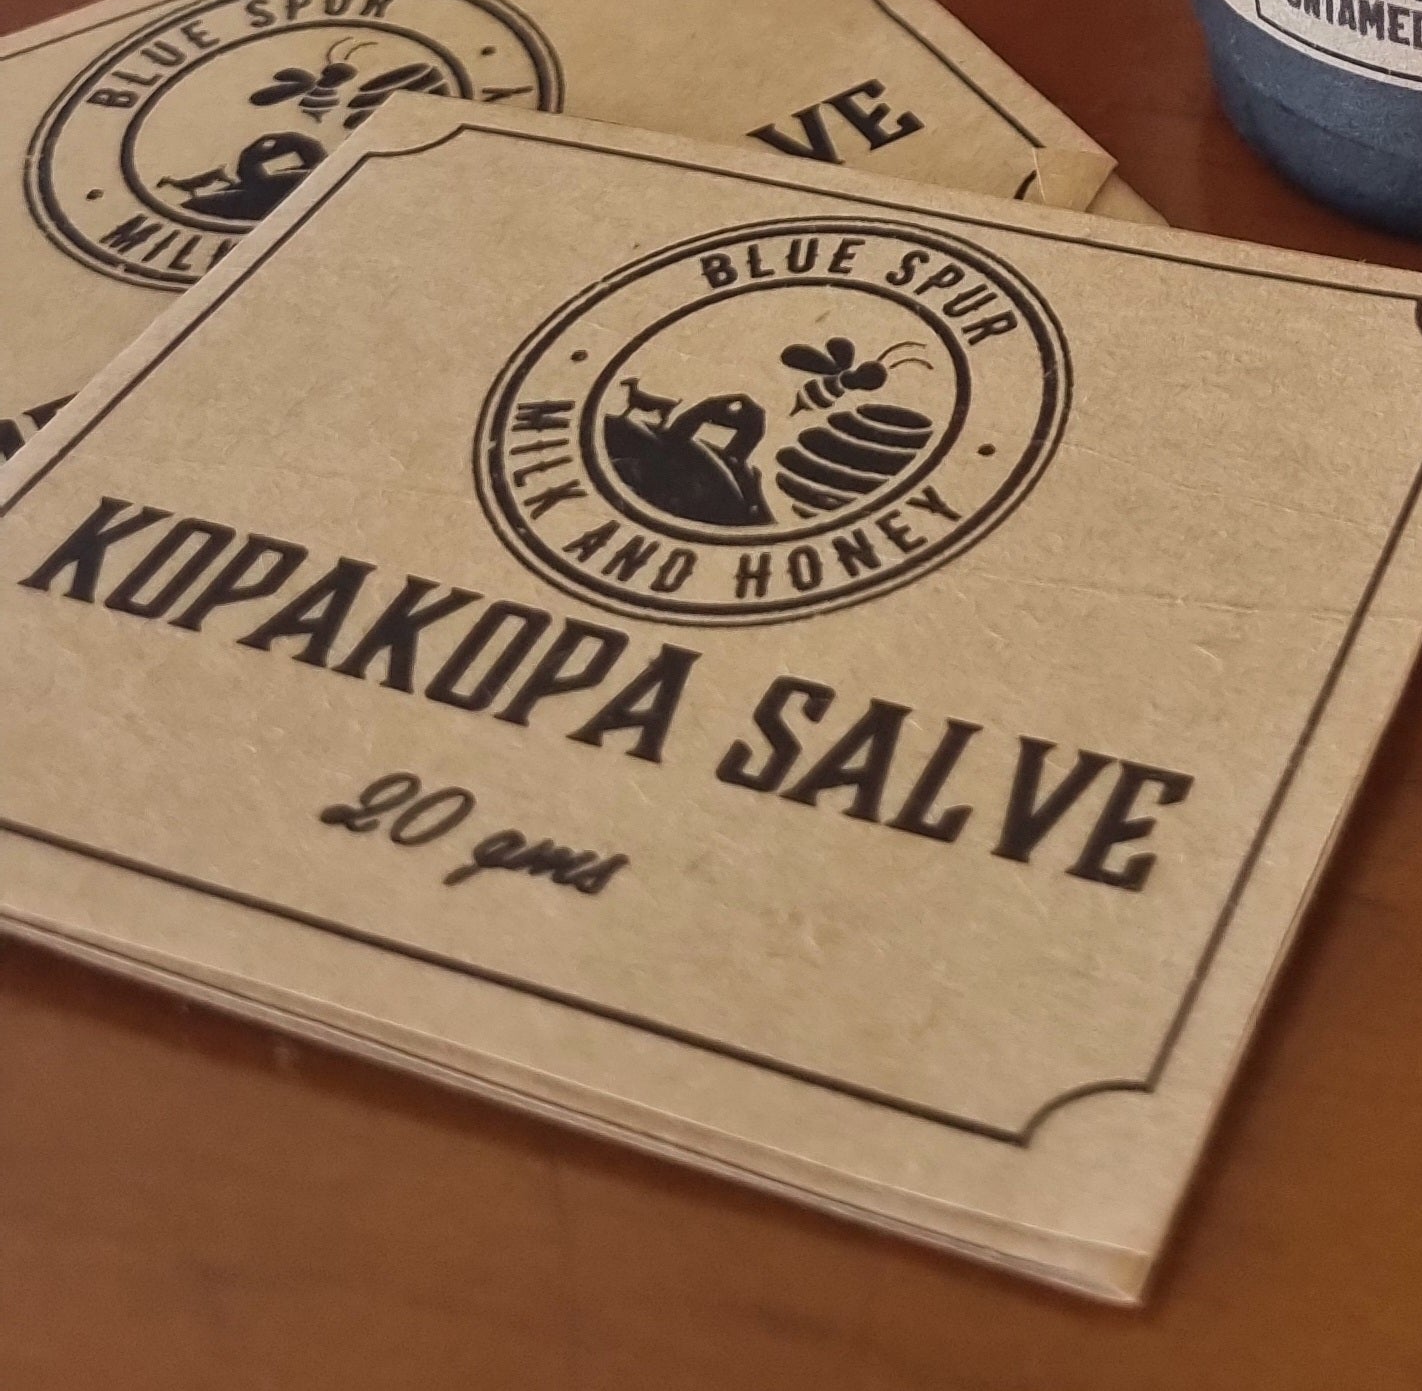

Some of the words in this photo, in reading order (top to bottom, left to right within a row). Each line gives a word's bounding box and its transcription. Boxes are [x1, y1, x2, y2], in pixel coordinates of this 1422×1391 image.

[87, 19, 220, 109] BLUE
[700, 238, 866, 289] BLUE
[886, 249, 1019, 346] SPUR
[512, 399, 588, 520] MILK
[562, 519, 697, 593] AND
[734, 487, 963, 599] HONEY
[18, 496, 703, 763] KOPAKOPA
[714, 674, 1196, 892] SALVE
[320, 771, 476, 847] 20
[443, 828, 631, 895] gms
